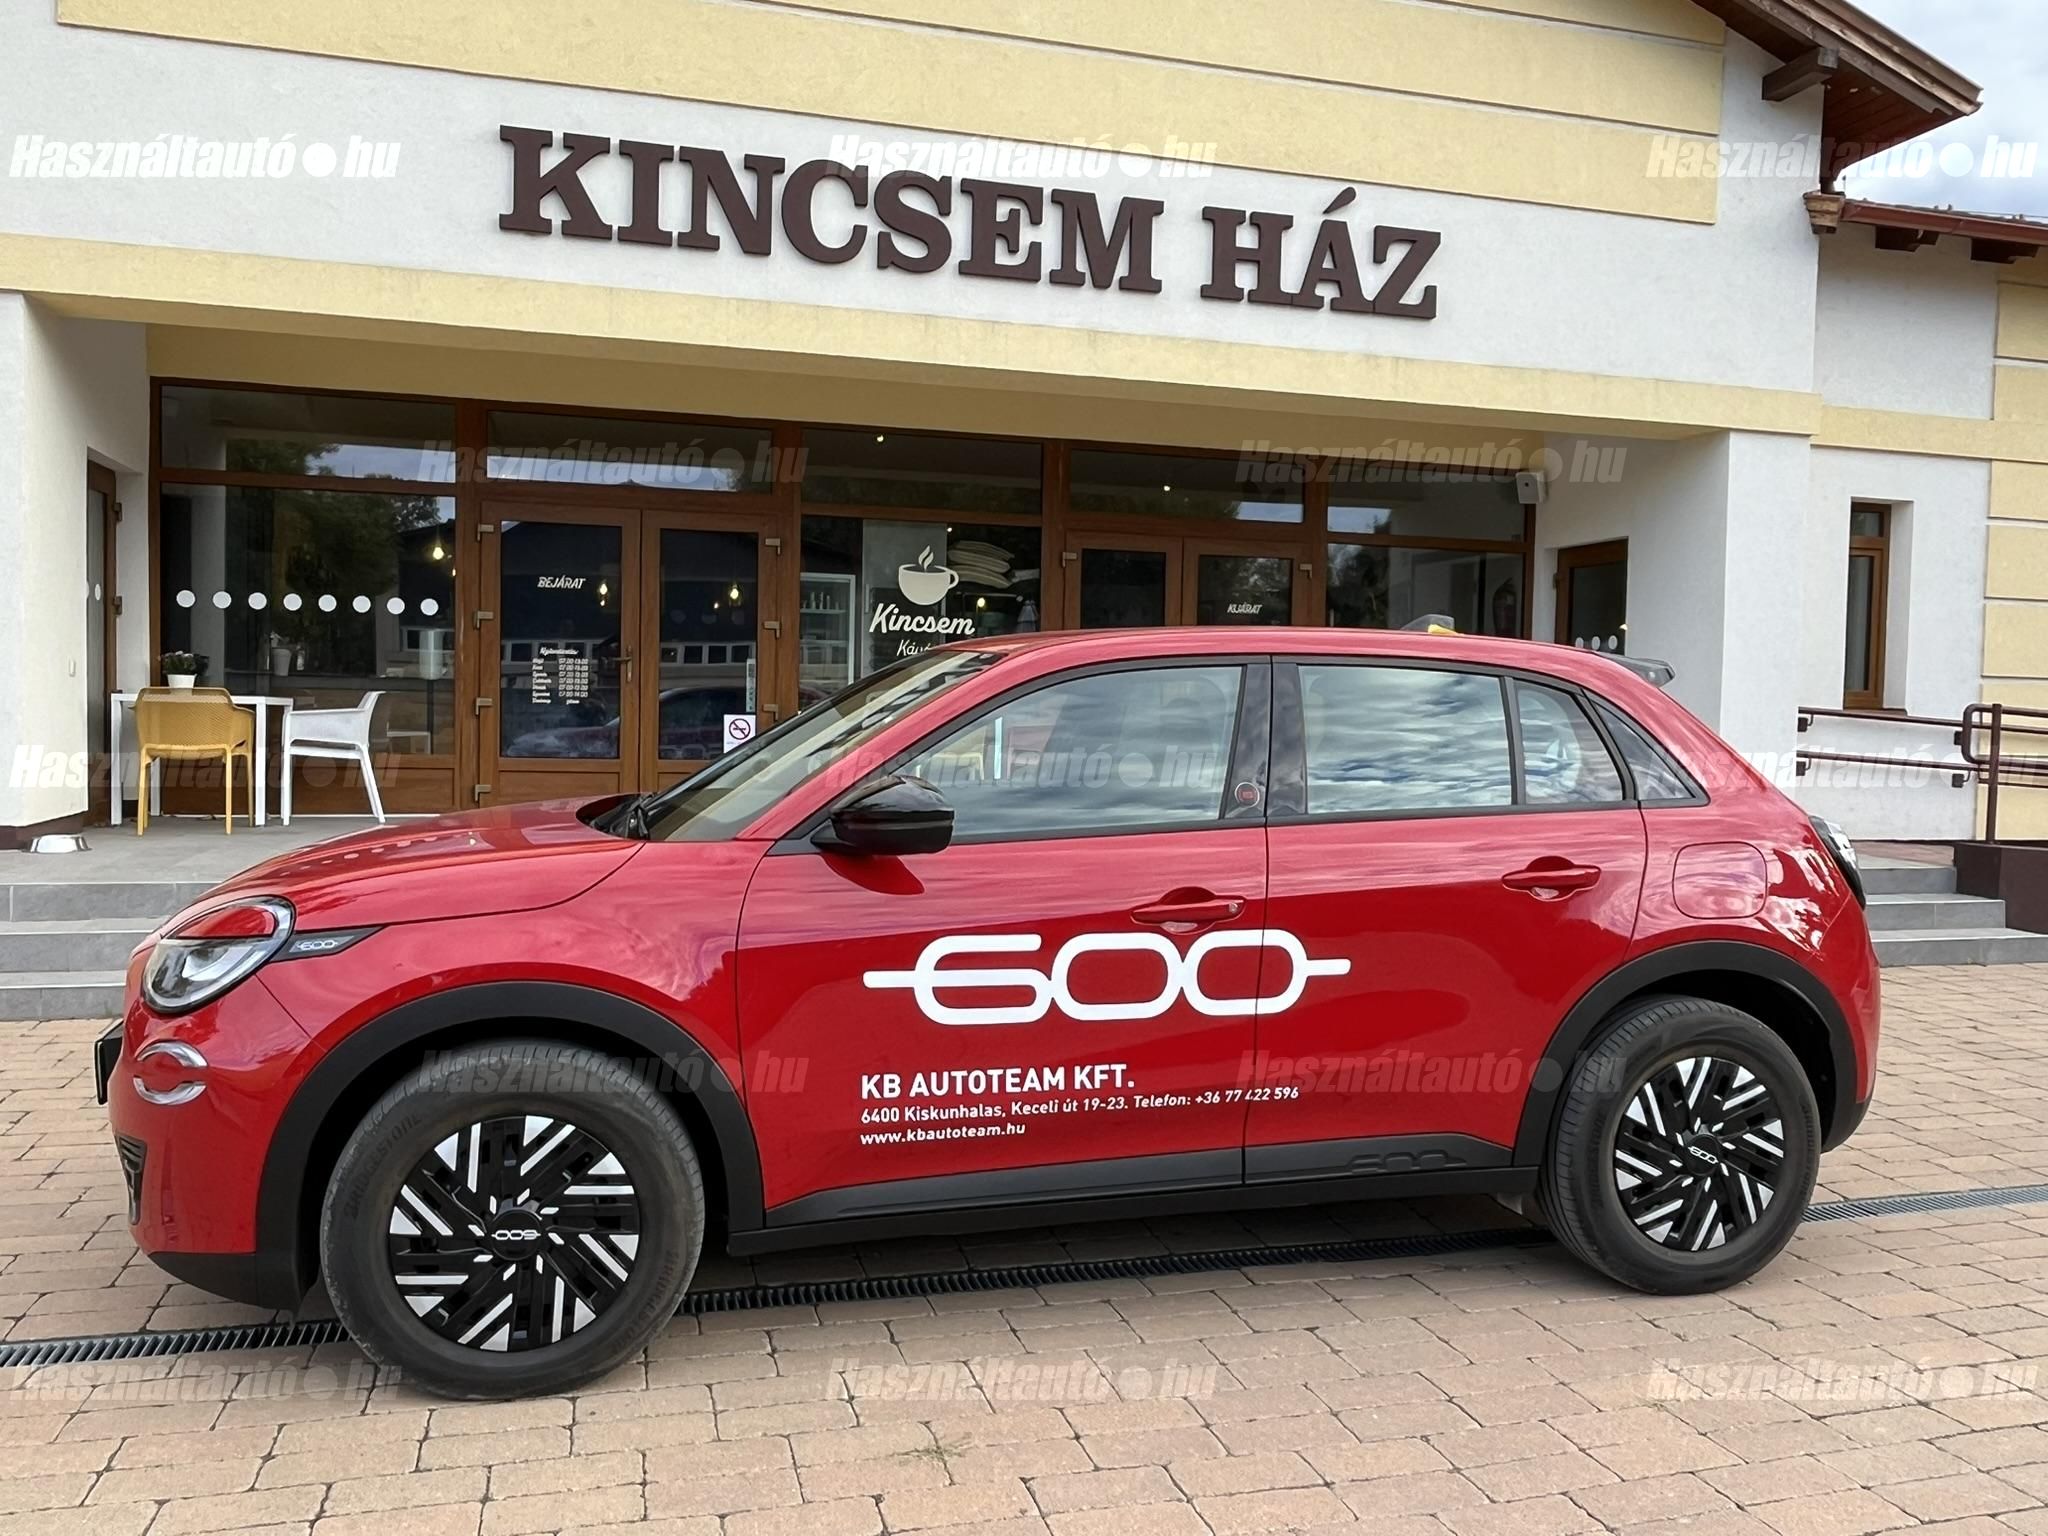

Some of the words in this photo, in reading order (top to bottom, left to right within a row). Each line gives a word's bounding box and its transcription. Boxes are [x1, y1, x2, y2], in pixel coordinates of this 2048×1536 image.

[499, 124, 1164, 295] KINCSEM
[1200, 186, 1442, 321] HÁZ
[537, 574, 586, 590] BEJÁRAT
[869, 603, 976, 635] Kincsem
[297, 939, 338, 951] 600
[863, 928, 1352, 1026] 600
[861, 1073, 901, 1099] KB
[909, 1066, 1065, 1098] AUTOTEAM
[1074, 1064, 1135, 1090] KFT.
[861, 1107, 900, 1124] 6400
[904, 1104, 1006, 1122] Kiskunhalas,
[1011, 1098, 1059, 1116] Keceli
[1063, 1099, 1079, 1113] út
[1083, 1097, 1129, 1112] 19-23.
[1134, 1094, 1191, 1109] Telefon:
[1195, 1090, 1220, 1105] +36
[1225, 1089, 1243, 1103] 77
[1273, 1086, 1299, 1100] 596
[860, 1123, 1026, 1145] www.kbautoteam.hu
